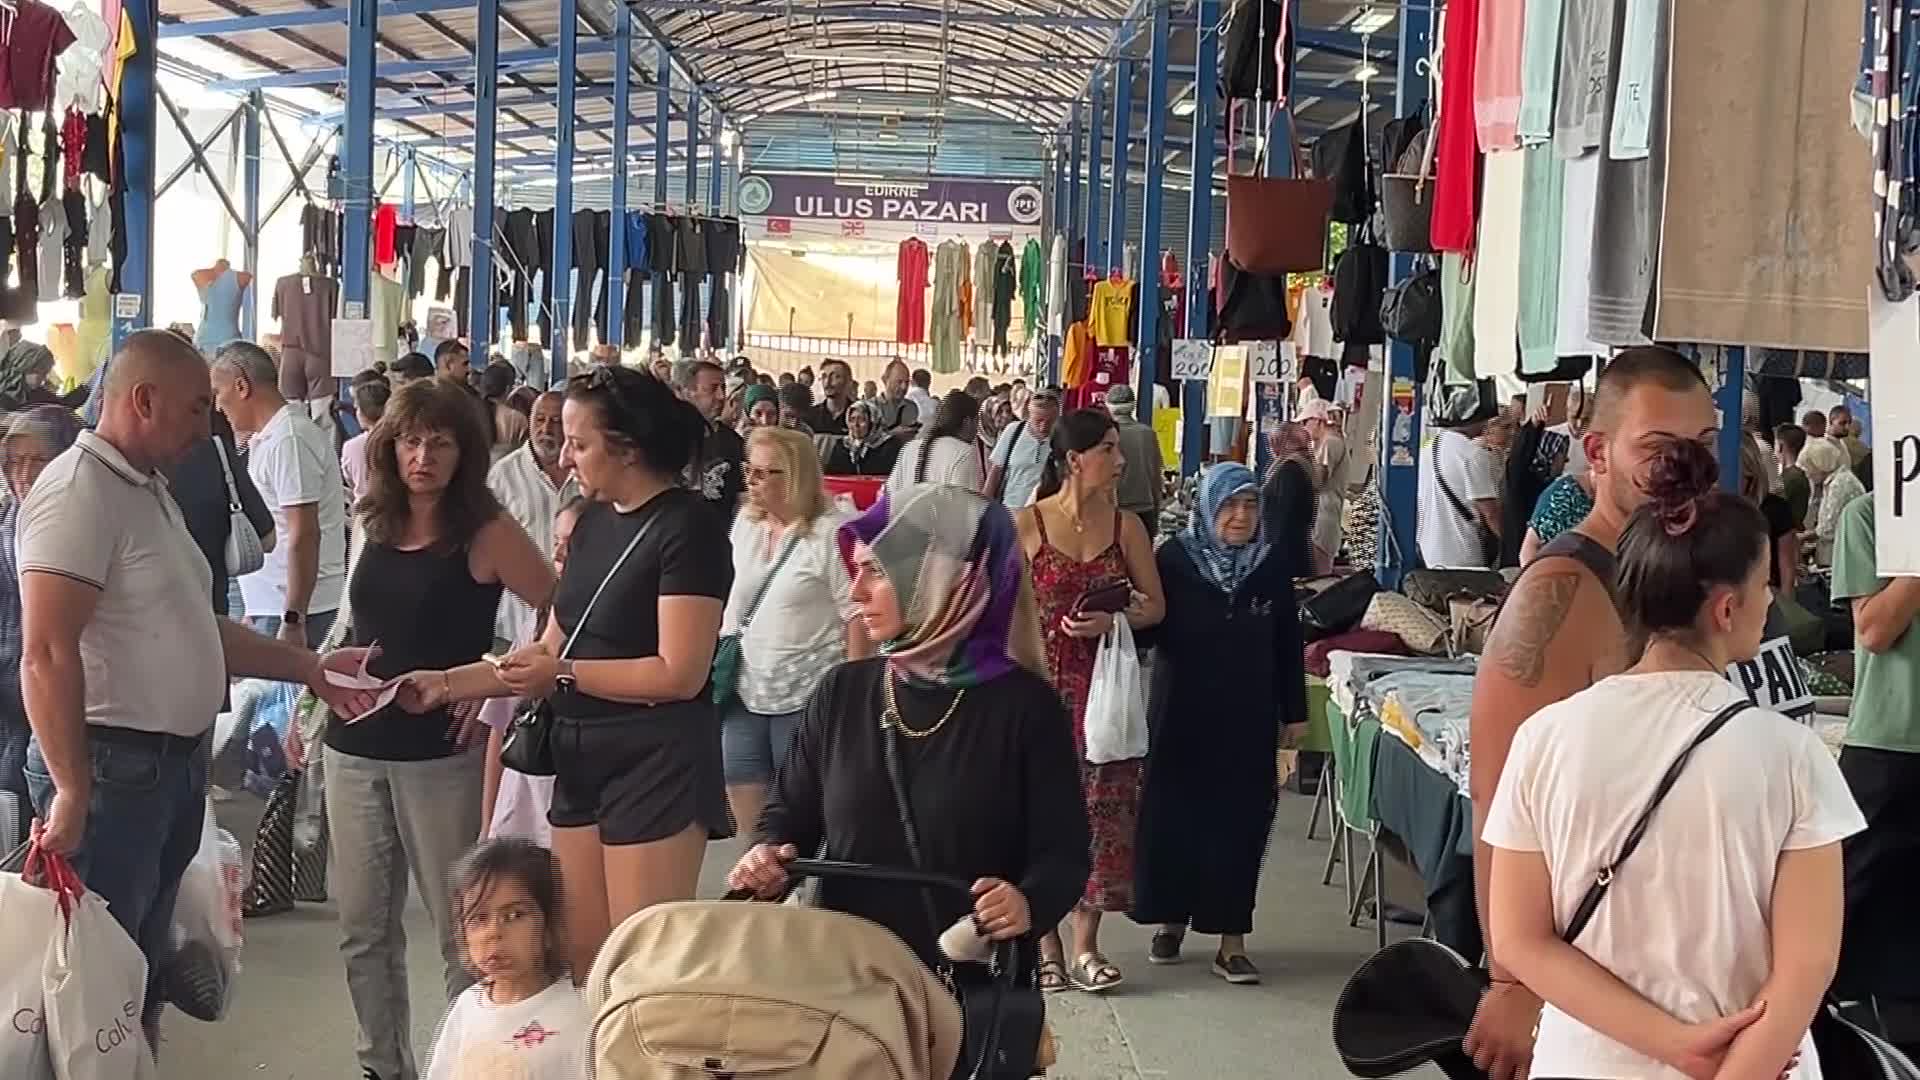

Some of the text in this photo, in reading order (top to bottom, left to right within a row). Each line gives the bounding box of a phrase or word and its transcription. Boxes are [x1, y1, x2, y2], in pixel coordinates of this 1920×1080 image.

[794, 196, 987, 222] ULUS PAZARI
[1255, 356, 1291, 376] 200
